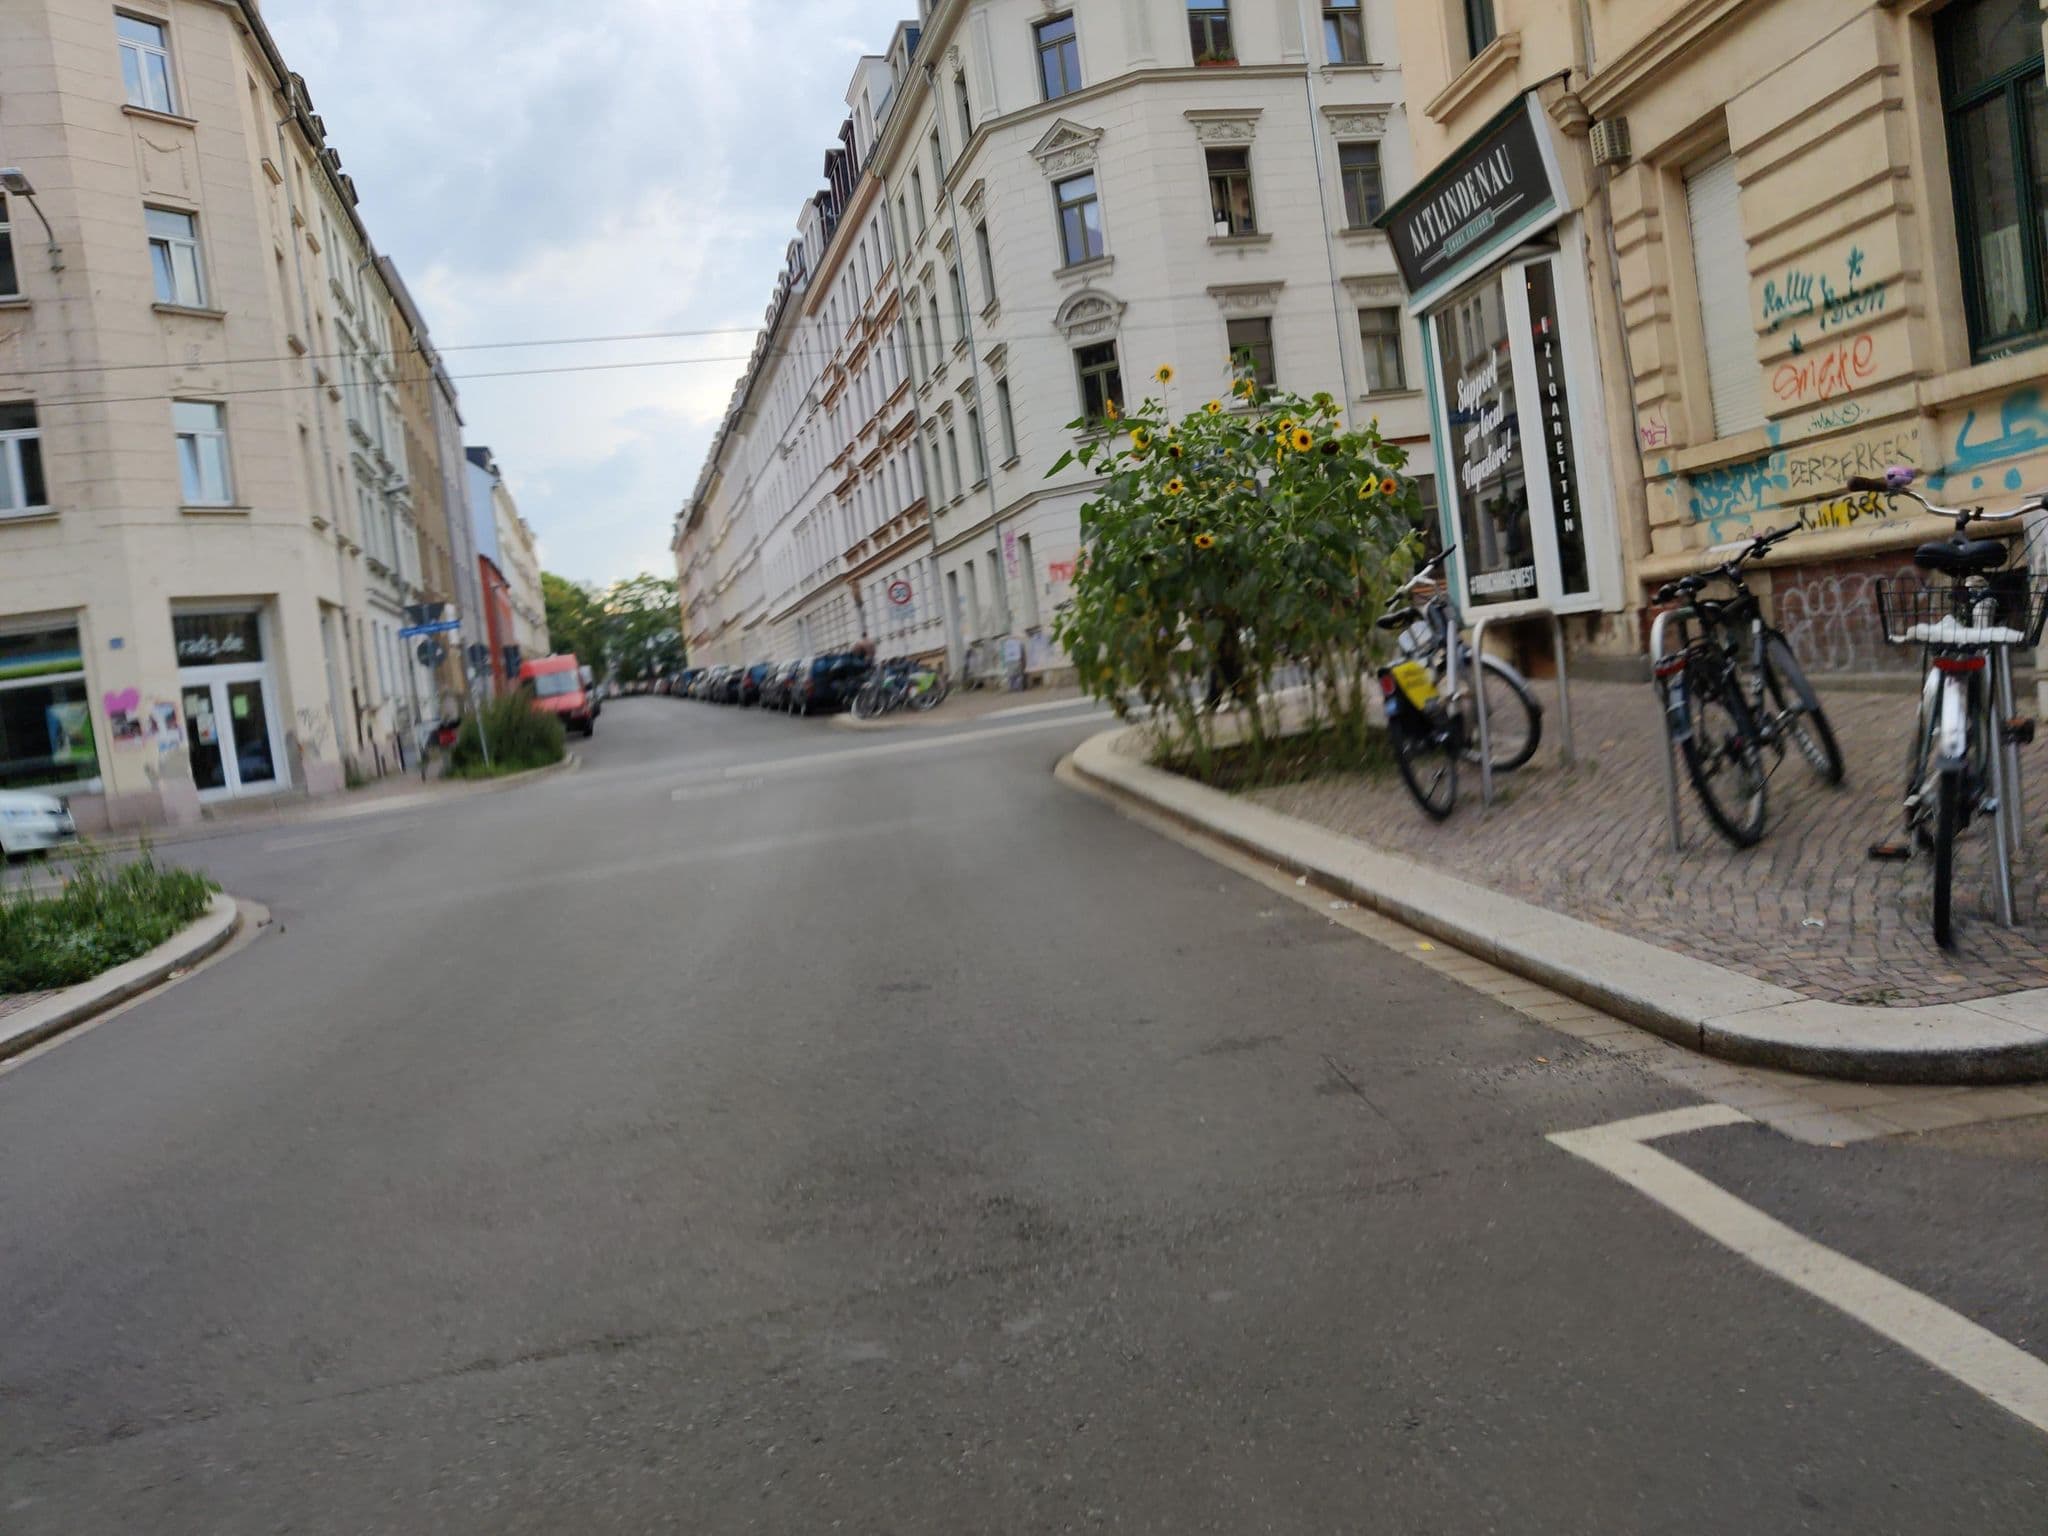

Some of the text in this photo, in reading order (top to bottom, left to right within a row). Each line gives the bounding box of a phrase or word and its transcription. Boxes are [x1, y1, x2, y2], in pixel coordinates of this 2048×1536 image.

[1408, 143, 1514, 258] ALTLINDENAU
[1457, 348, 1498, 414] Support
[1480, 390, 1504, 438] local
